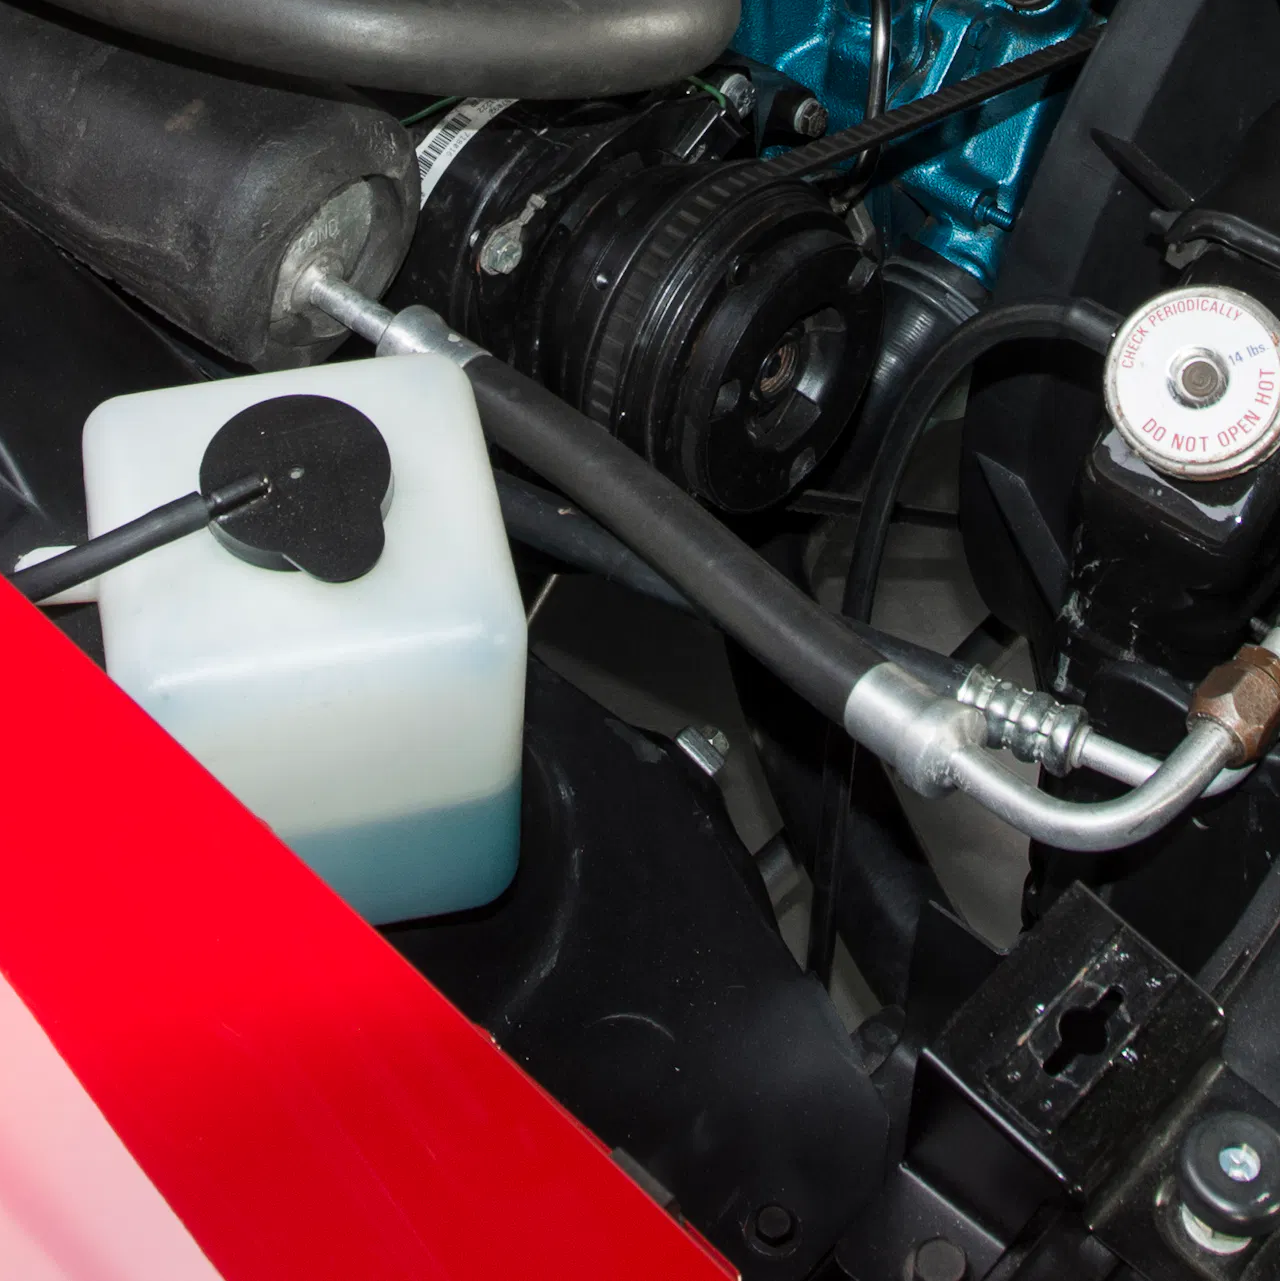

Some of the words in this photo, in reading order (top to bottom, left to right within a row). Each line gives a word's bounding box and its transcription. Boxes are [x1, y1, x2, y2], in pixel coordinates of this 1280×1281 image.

[1121, 326, 1149, 369] CHECK
[1148, 298, 1243, 327] PERIODICALLY
[1228, 351, 1243, 366] 14
[1141, 417, 1167, 442] DO
[1170, 433, 1209, 453] NOT
[1217, 409, 1261, 448] OPEN
[1255, 368, 1275, 405] HOT
